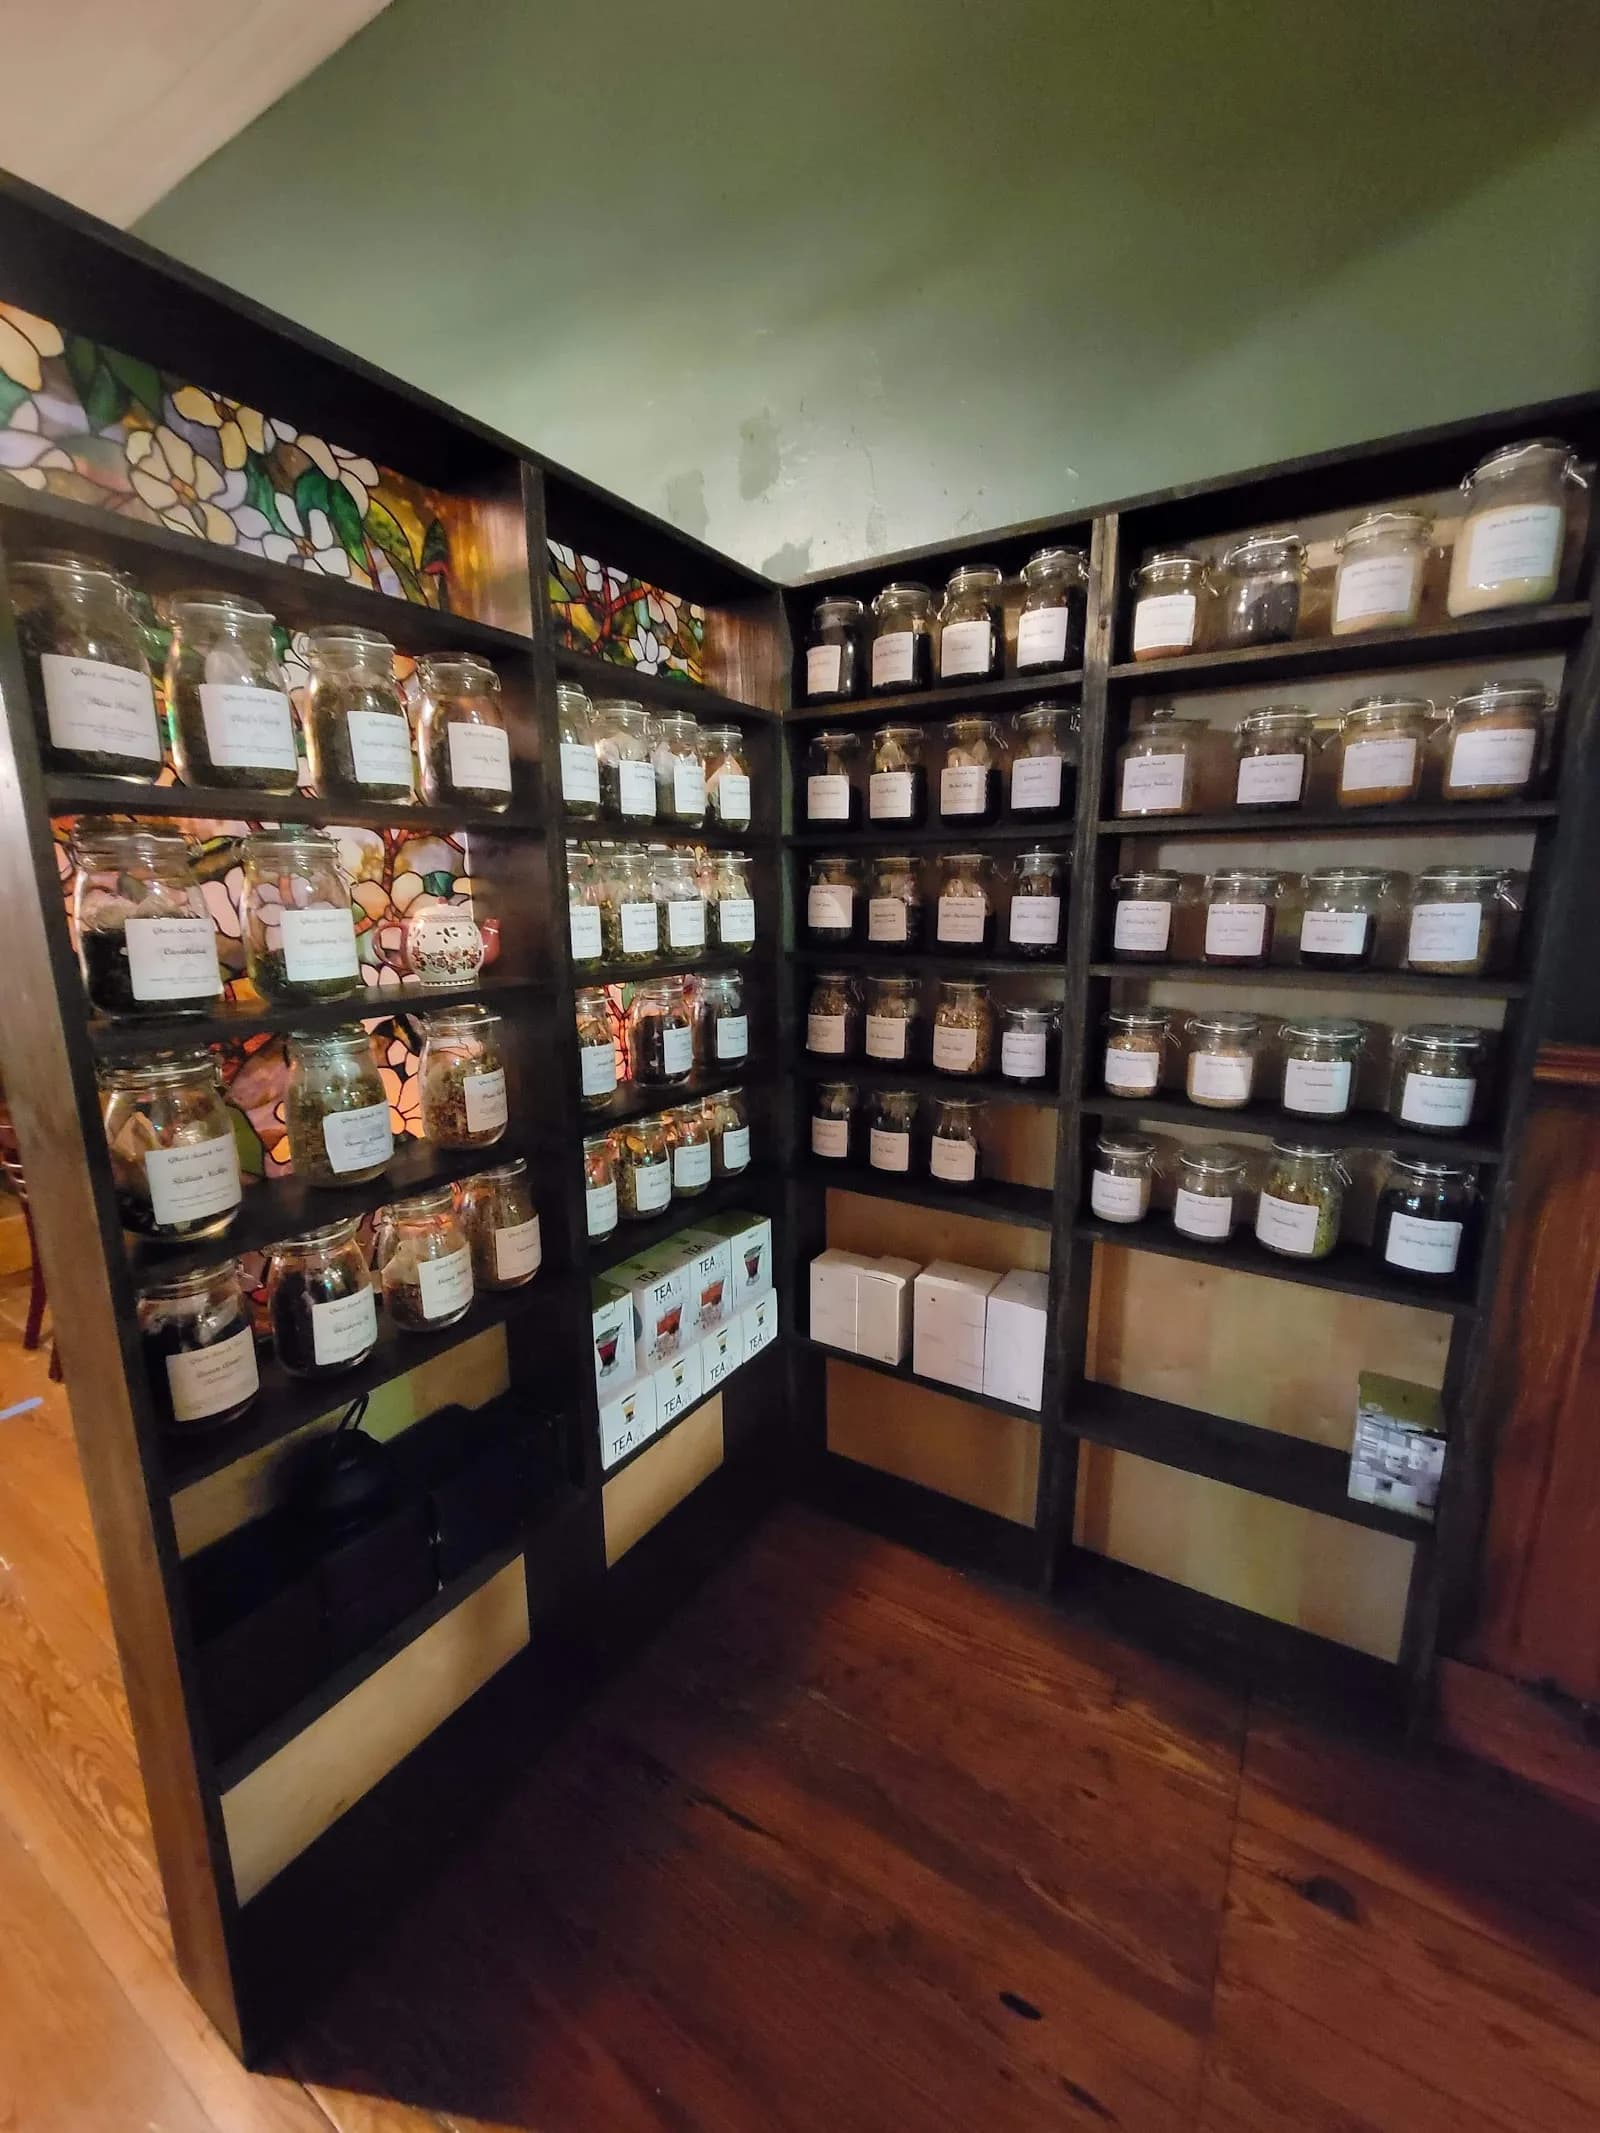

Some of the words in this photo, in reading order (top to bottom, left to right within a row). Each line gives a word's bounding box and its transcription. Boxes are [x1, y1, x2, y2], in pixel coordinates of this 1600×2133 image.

[699, 1255, 715, 1273] TEA
[654, 1281, 672, 1302] TEA
[750, 1333, 764, 1350] TEA
[710, 1361, 726, 1381] TEA
[664, 1394, 682, 1416] TEA
[612, 1431, 633, 1455] TEA
